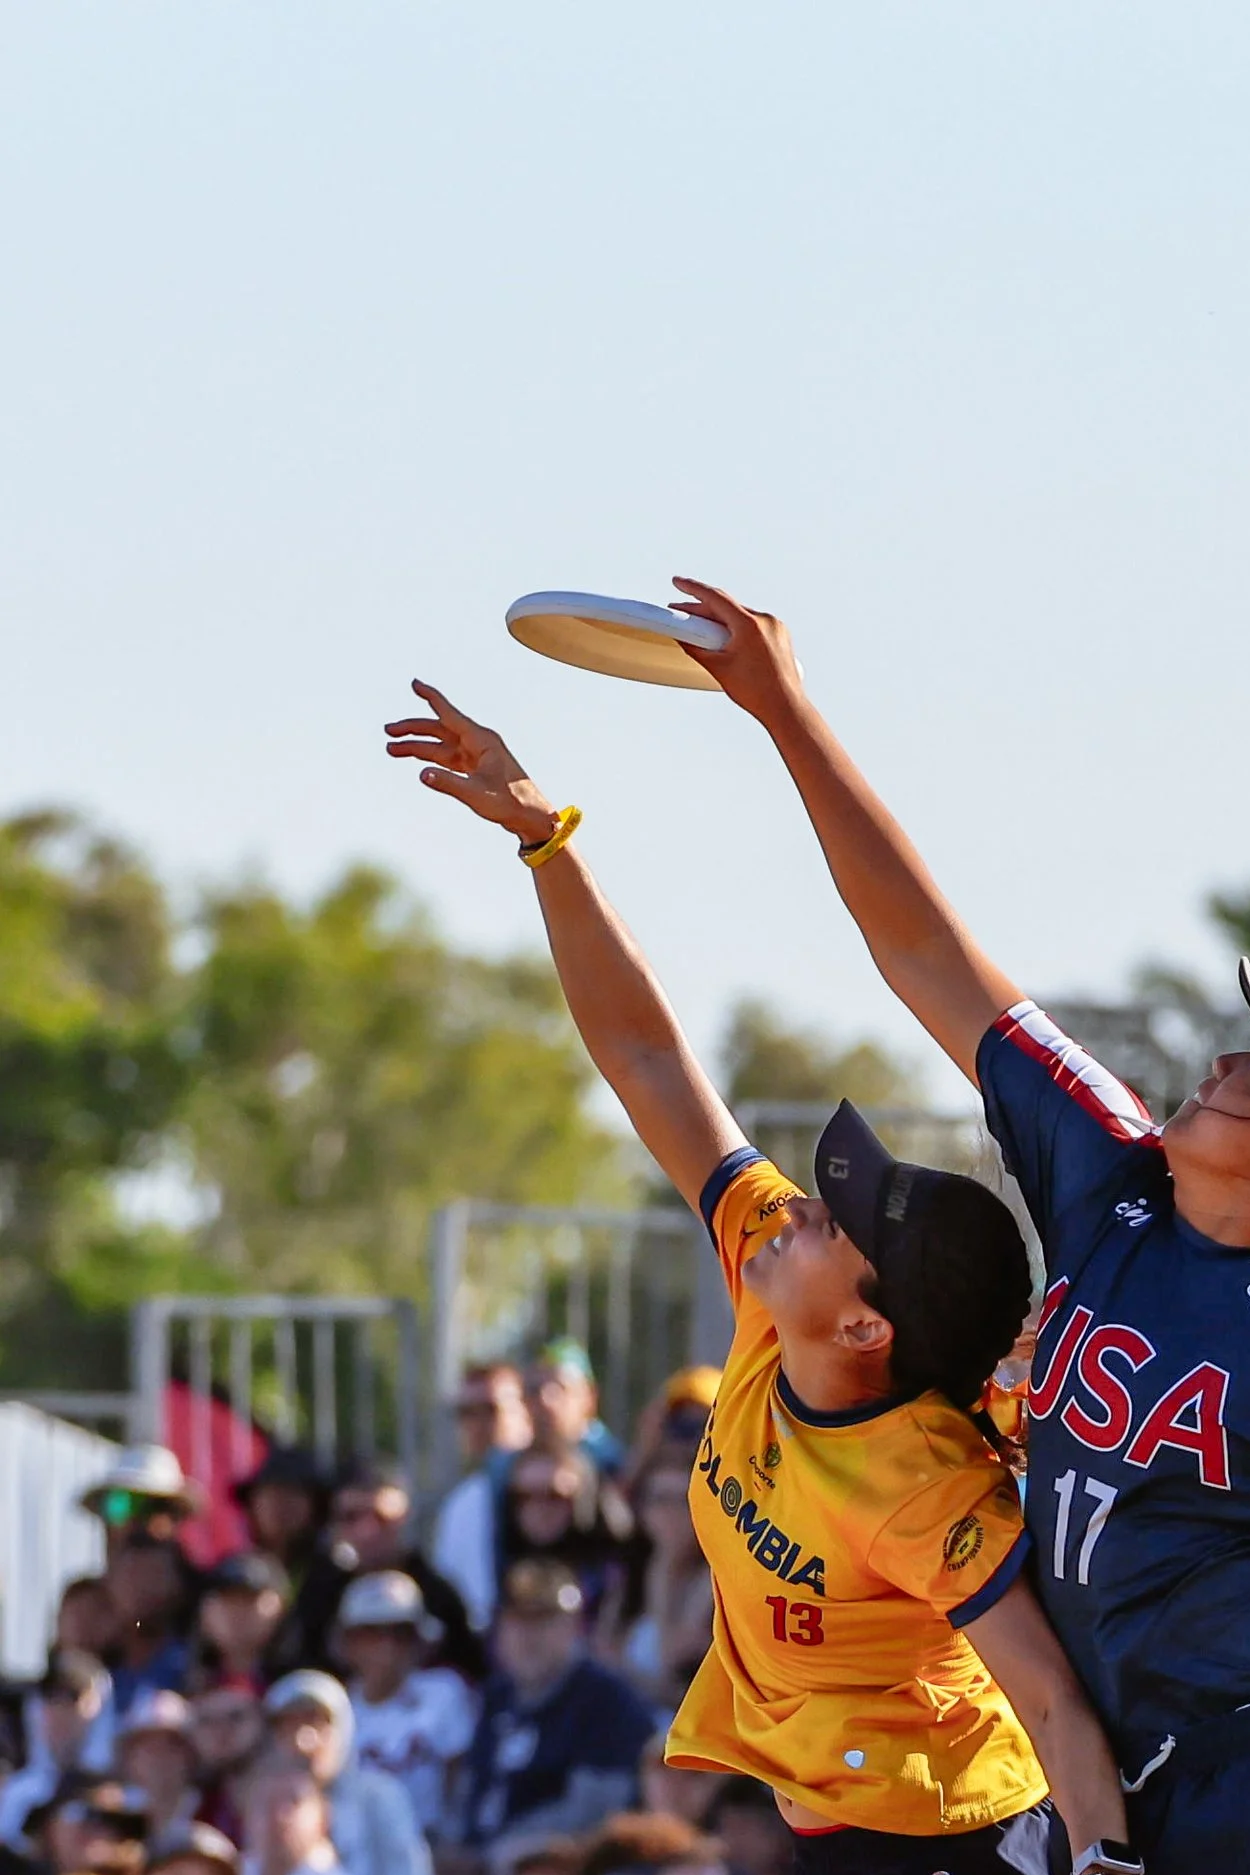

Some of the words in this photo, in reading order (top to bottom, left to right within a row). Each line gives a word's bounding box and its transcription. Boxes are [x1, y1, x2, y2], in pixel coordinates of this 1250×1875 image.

[828, 1157, 849, 1180] 13
[1027, 1276, 1232, 1491] USA
[1053, 1468, 1119, 1585] 17
[765, 1595, 825, 1646] 13
